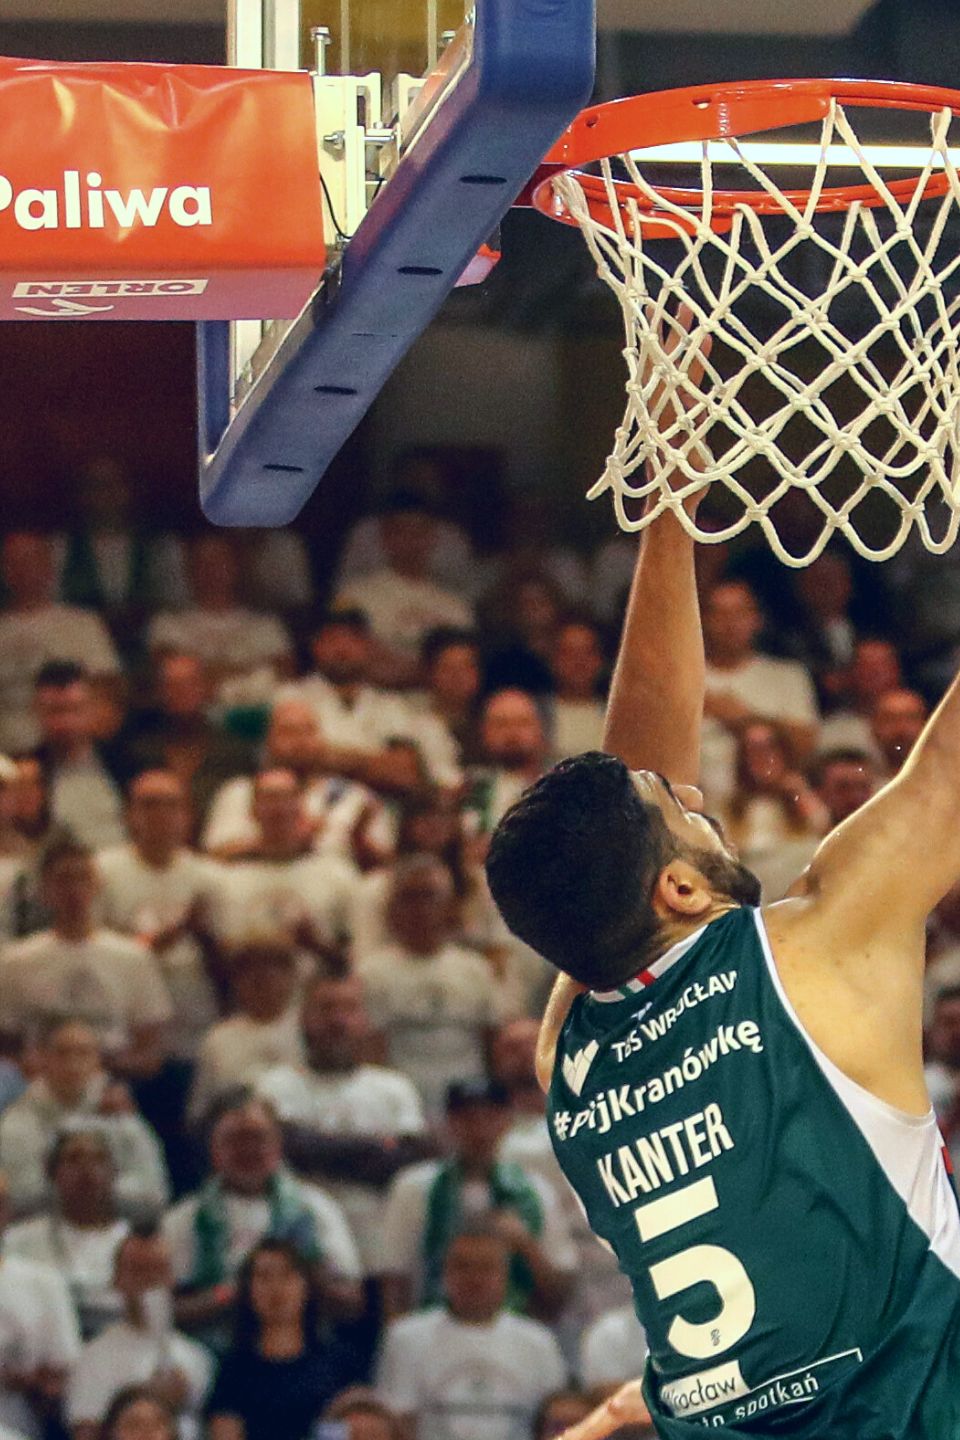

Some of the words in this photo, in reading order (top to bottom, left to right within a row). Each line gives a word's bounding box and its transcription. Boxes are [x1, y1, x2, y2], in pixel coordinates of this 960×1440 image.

[27, 282, 195, 295] ORLEN
[597, 1102, 735, 1208] KANTER
[634, 1175, 756, 1360] 5
